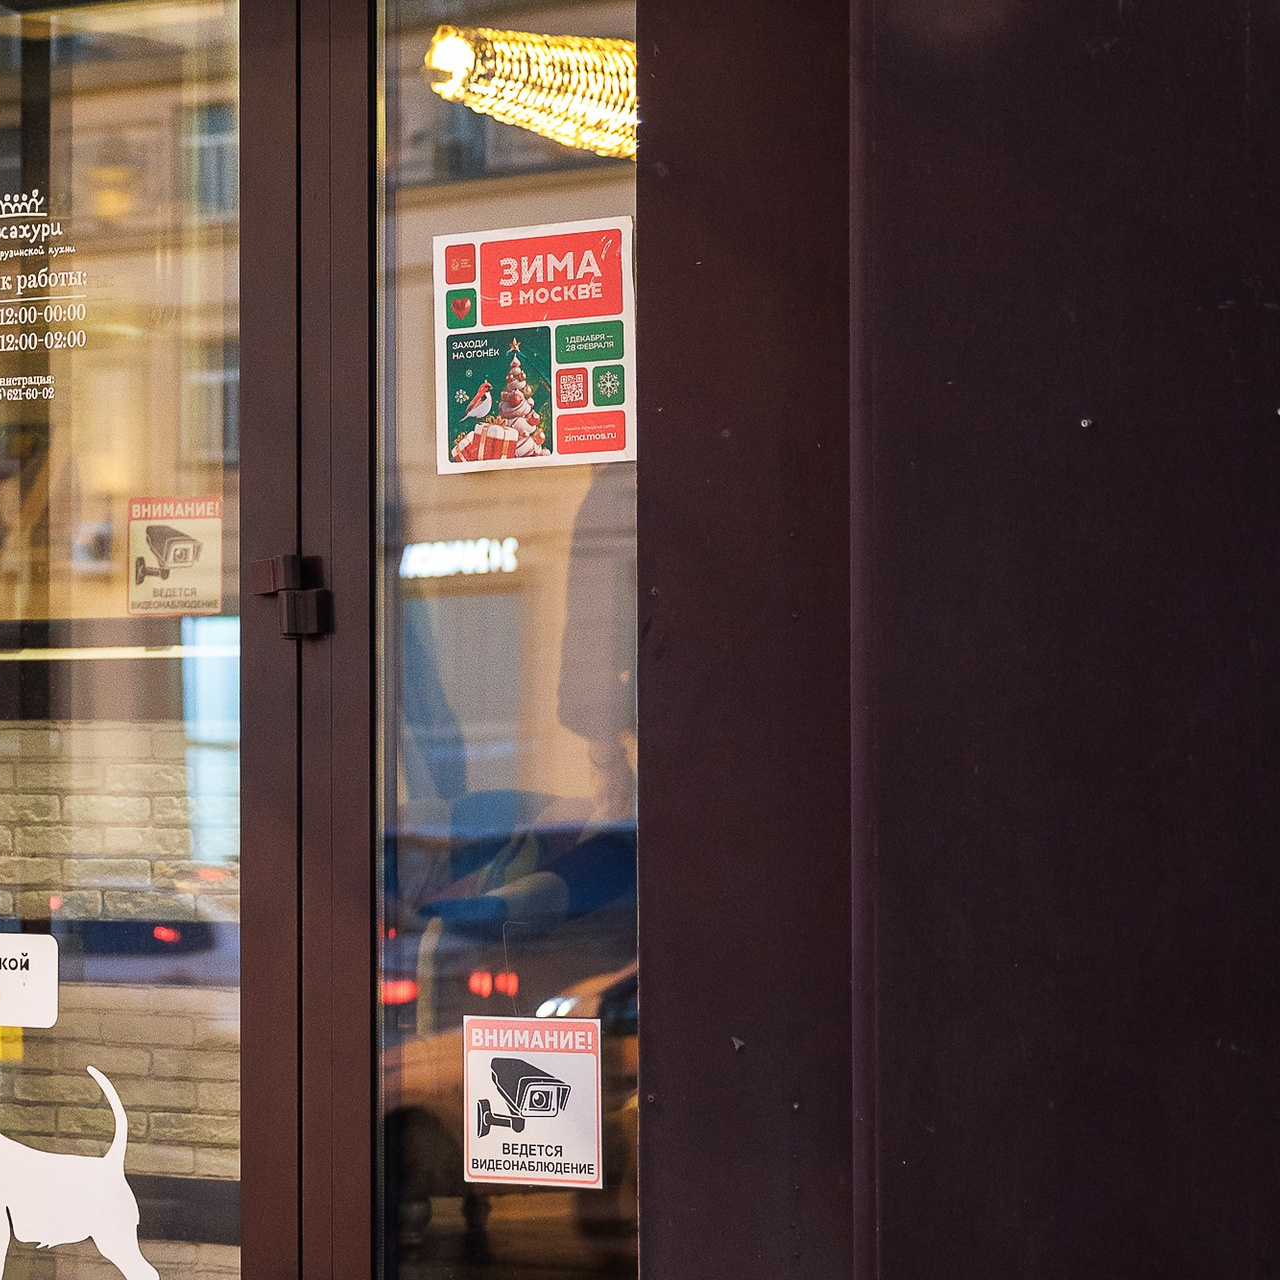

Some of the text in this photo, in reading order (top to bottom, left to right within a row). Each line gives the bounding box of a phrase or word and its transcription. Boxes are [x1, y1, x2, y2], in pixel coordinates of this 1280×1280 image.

[48, 245, 76, 258] кухни
[499, 249, 602, 287] ЗИМА
[16, 267, 87, 295] работы:
[499, 282, 603, 308] В МОСКВЕ
[452, 339, 488, 350] ЗАХОДИ
[569, 333, 606, 344] ДЕКАБРЯ
[565, 340, 614, 352] 28 ФЕВРАЛЯ
[452, 347, 500, 360] НА ОГОНЁК
[564, 432, 617, 442] zima.mos.ru
[132, 501, 219, 518] ВНИМАНИЕ!
[471, 1028, 593, 1050] ВНИМАНИЕ!
[502, 1143, 563, 1157] ВЕДЕТСЯ
[471, 1158, 595, 1175] ВИДЕОНАБЛЮДЕНИЕ
